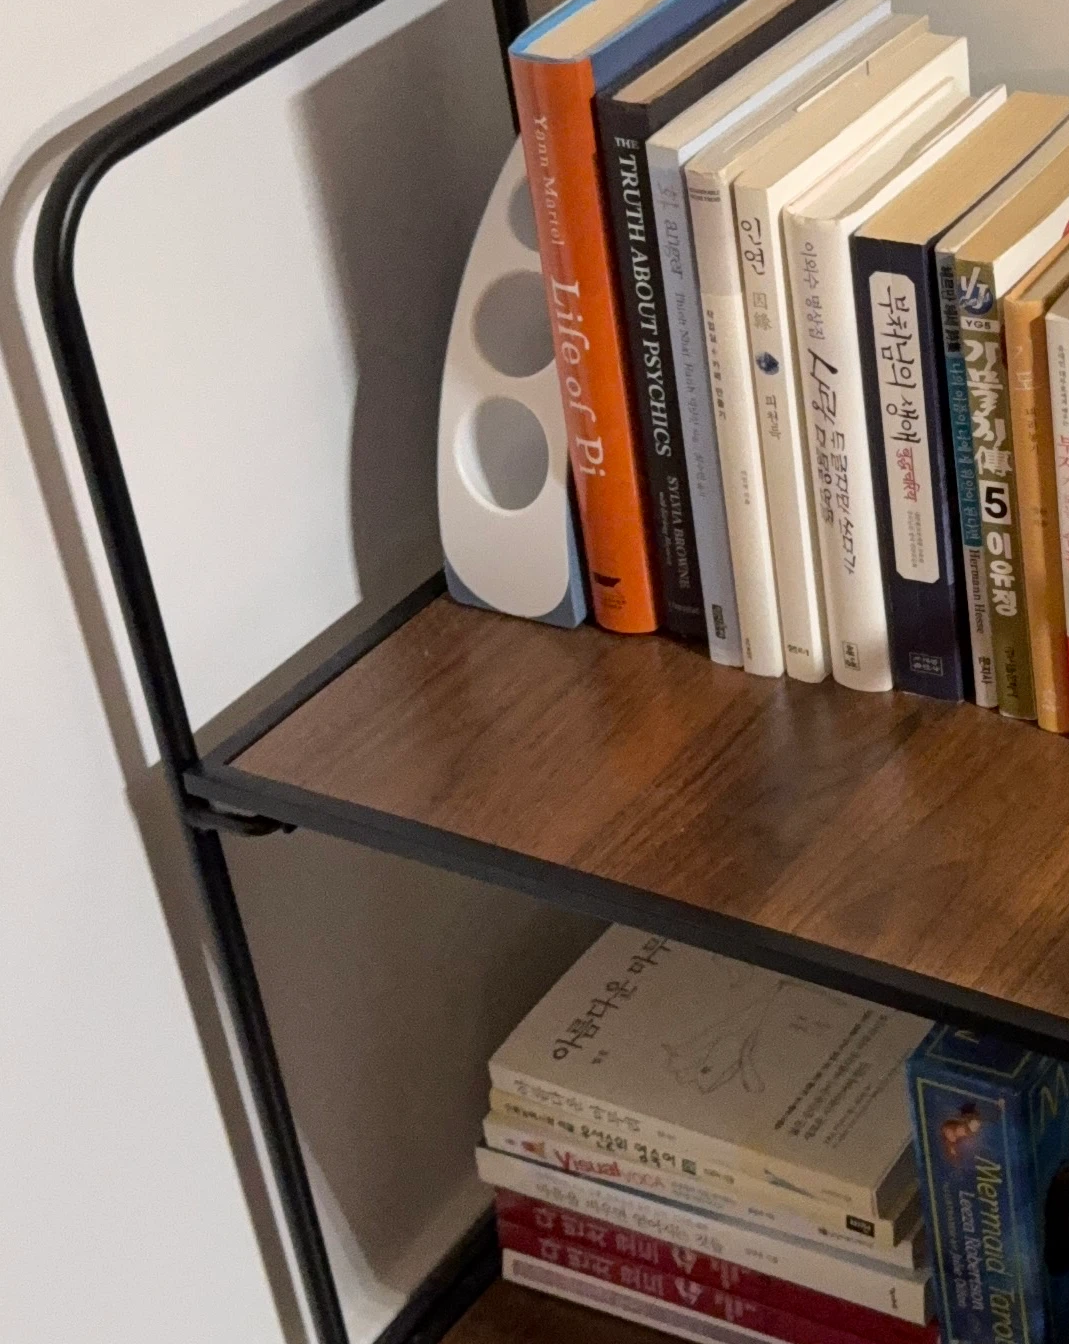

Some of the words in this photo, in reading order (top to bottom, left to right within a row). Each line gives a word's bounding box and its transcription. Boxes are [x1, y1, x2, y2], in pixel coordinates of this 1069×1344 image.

[614, 136, 640, 150] THE
[533, 116, 551, 167] Yann
[543, 176, 565, 246] Martel
[618, 153, 646, 250] TRUTH
[664, 219, 684, 281] anger
[741, 217, 766, 276] 인연
[801, 241, 819, 290] 이외수
[551, 278, 590, 365] Life
[631, 249, 658, 341] ABOUT
[805, 295, 826, 341] 명상집
[877, 285, 917, 389] 부처님의
[565, 378, 597, 423] of
[642, 339, 672, 458] PSYCHICS
[808, 348, 839, 426] 사랑
[814, 423, 827, 449] 다
[831, 430, 845, 452] 두
[885, 394, 922, 444] 생애
[574, 436, 606, 478] Pi
[831, 453, 851, 516] 글자만
[666, 475, 684, 526] SYLVIA
[985, 487, 1008, 518] 5
[674, 525, 692, 589] BROWNE
[838, 515, 857, 575] 쓰다가
[967, 549, 983, 600] Hermann
[973, 600, 987, 635] Hesse
[552, 980, 639, 1061] 아름다운
[552, 1149, 622, 1179] Visual
[634, 1142, 676, 1169] 영숙어
[958, 1189, 977, 1238] Leeza
[975, 1155, 1008, 1276] Mermaid
[963, 1237, 984, 1312] Robertson
